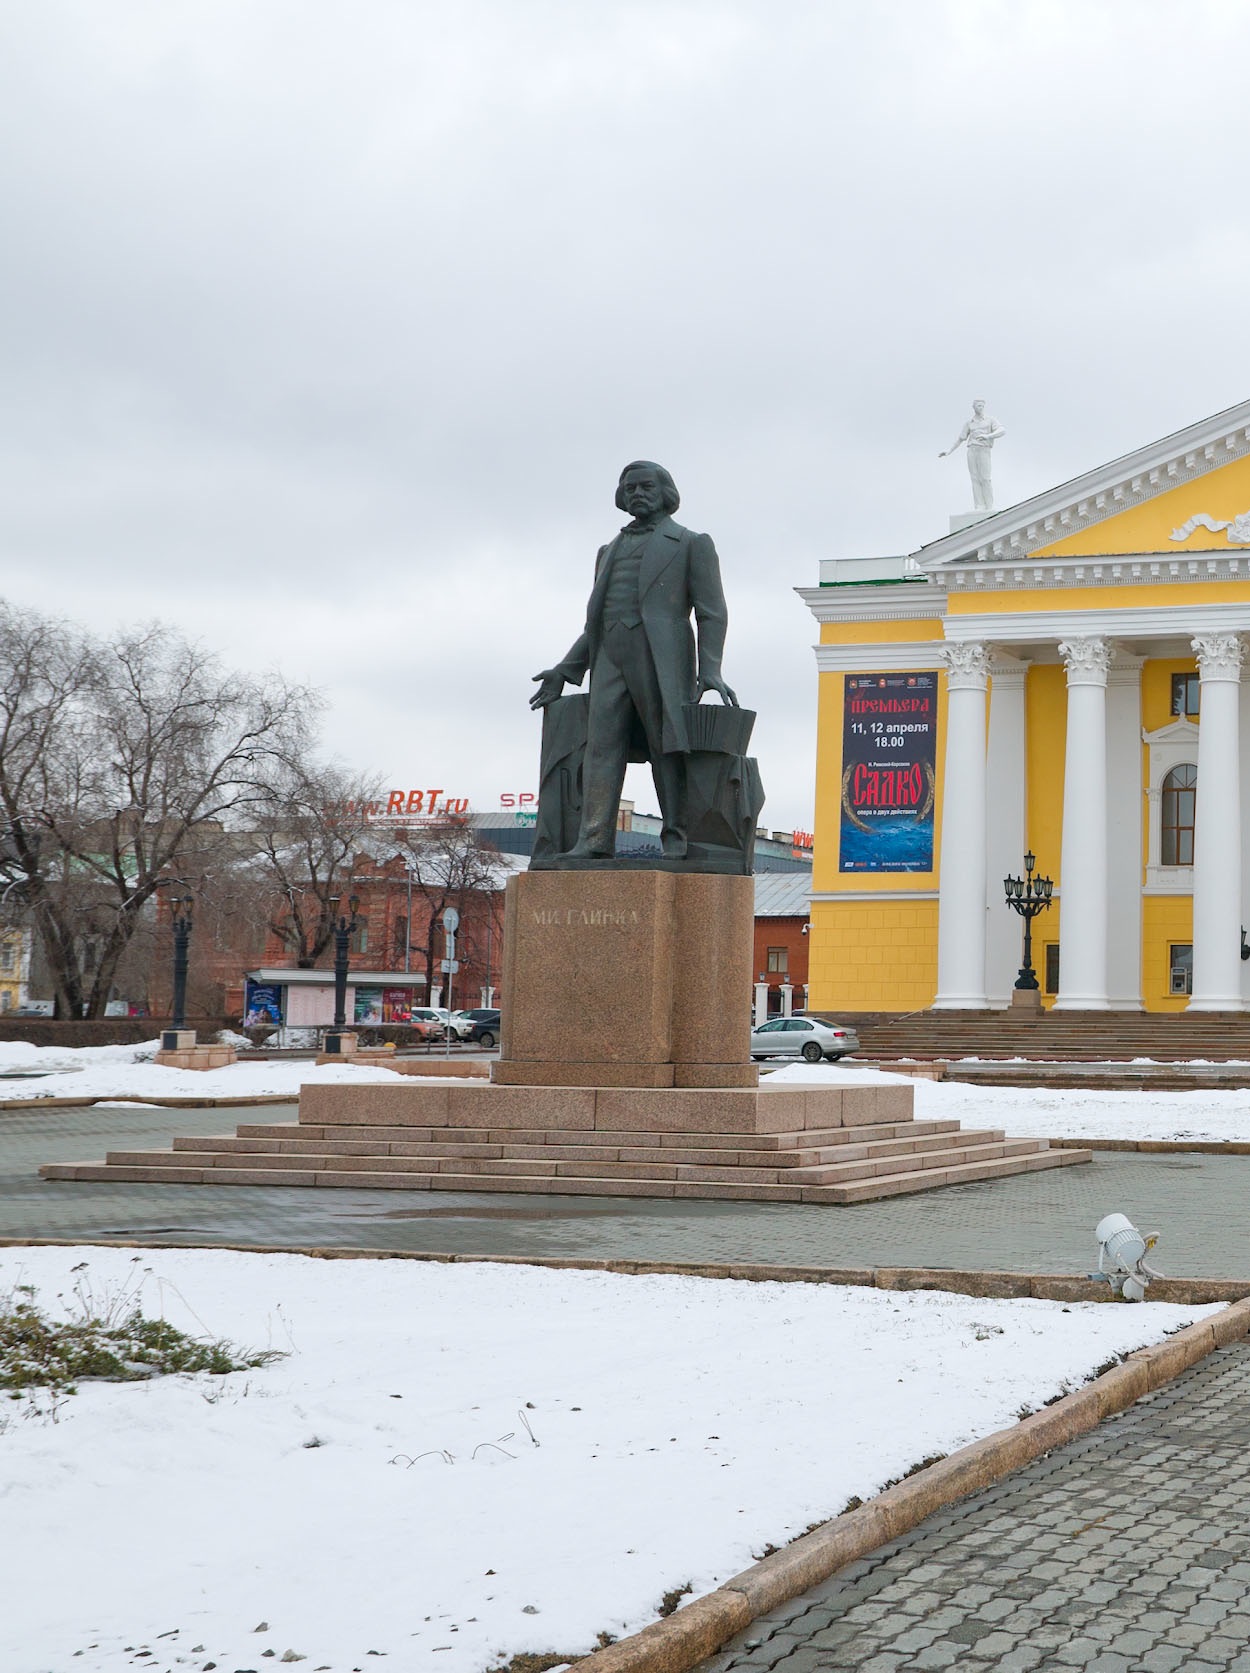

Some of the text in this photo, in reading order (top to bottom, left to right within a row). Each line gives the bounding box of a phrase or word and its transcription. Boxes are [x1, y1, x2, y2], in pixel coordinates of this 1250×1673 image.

[851, 698, 929, 713] ПРЕМЬЕРА
[851, 722, 929, 735] 11, 12 апреля
[874, 736, 905, 747] 18.00
[500, 793, 539, 806] SP
